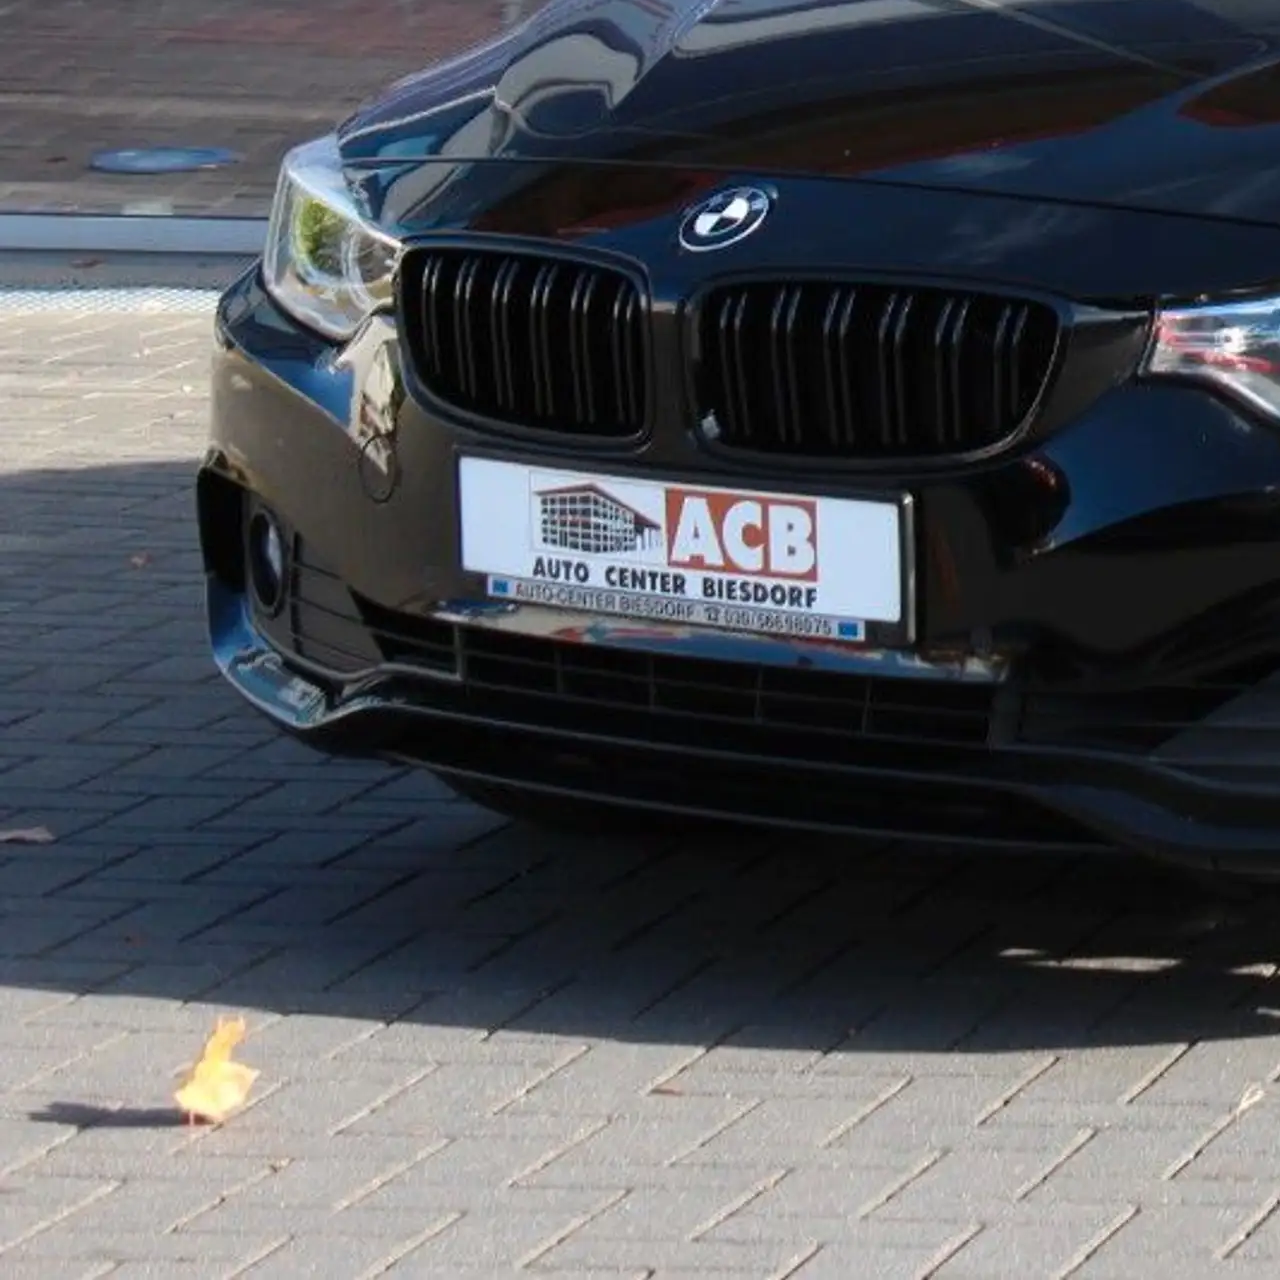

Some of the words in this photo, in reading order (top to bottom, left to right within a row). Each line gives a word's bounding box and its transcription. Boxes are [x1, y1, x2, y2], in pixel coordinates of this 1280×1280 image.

[669, 495, 816, 575] ACB
[532, 557, 590, 583] AUTO
[604, 564, 686, 595] CENTER
[702, 576, 818, 608] BIESDORF
[619, 595, 696, 618] BIESDORF
